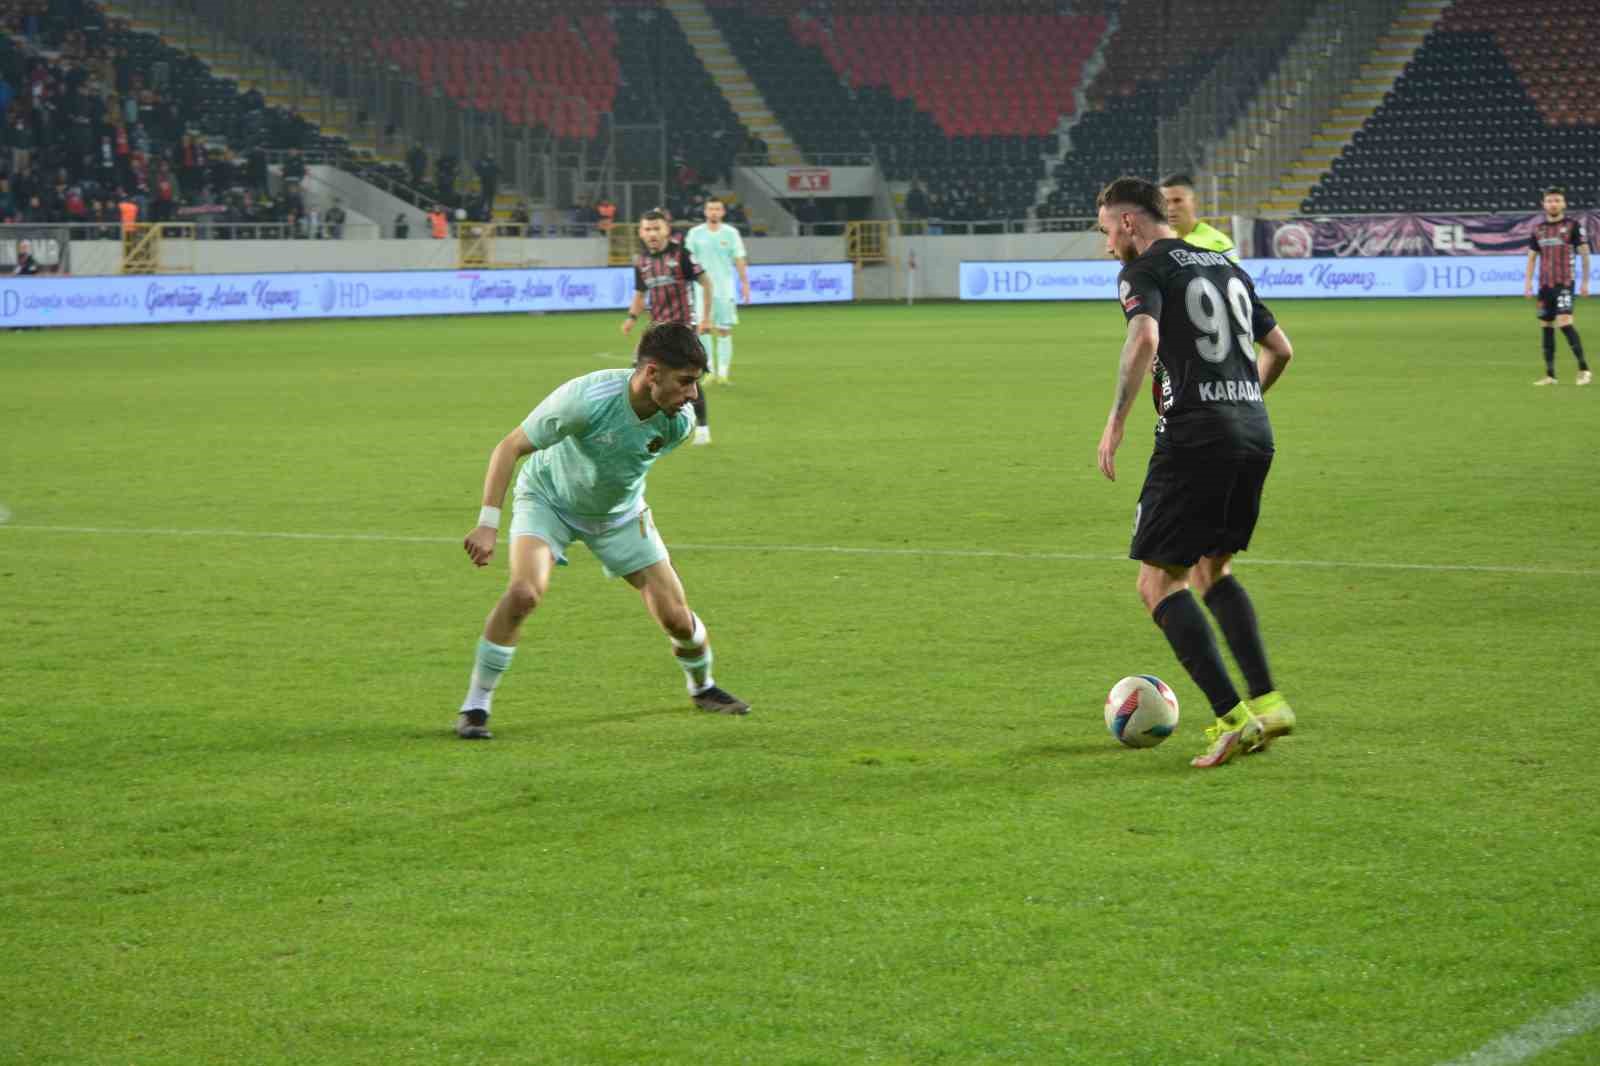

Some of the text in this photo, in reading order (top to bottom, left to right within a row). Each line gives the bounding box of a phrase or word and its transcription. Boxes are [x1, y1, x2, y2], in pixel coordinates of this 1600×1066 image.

[994, 270, 1033, 293] HD
[1432, 265, 1476, 290] HD
[339, 281, 369, 309] HD
[1185, 276, 1257, 363] 99
